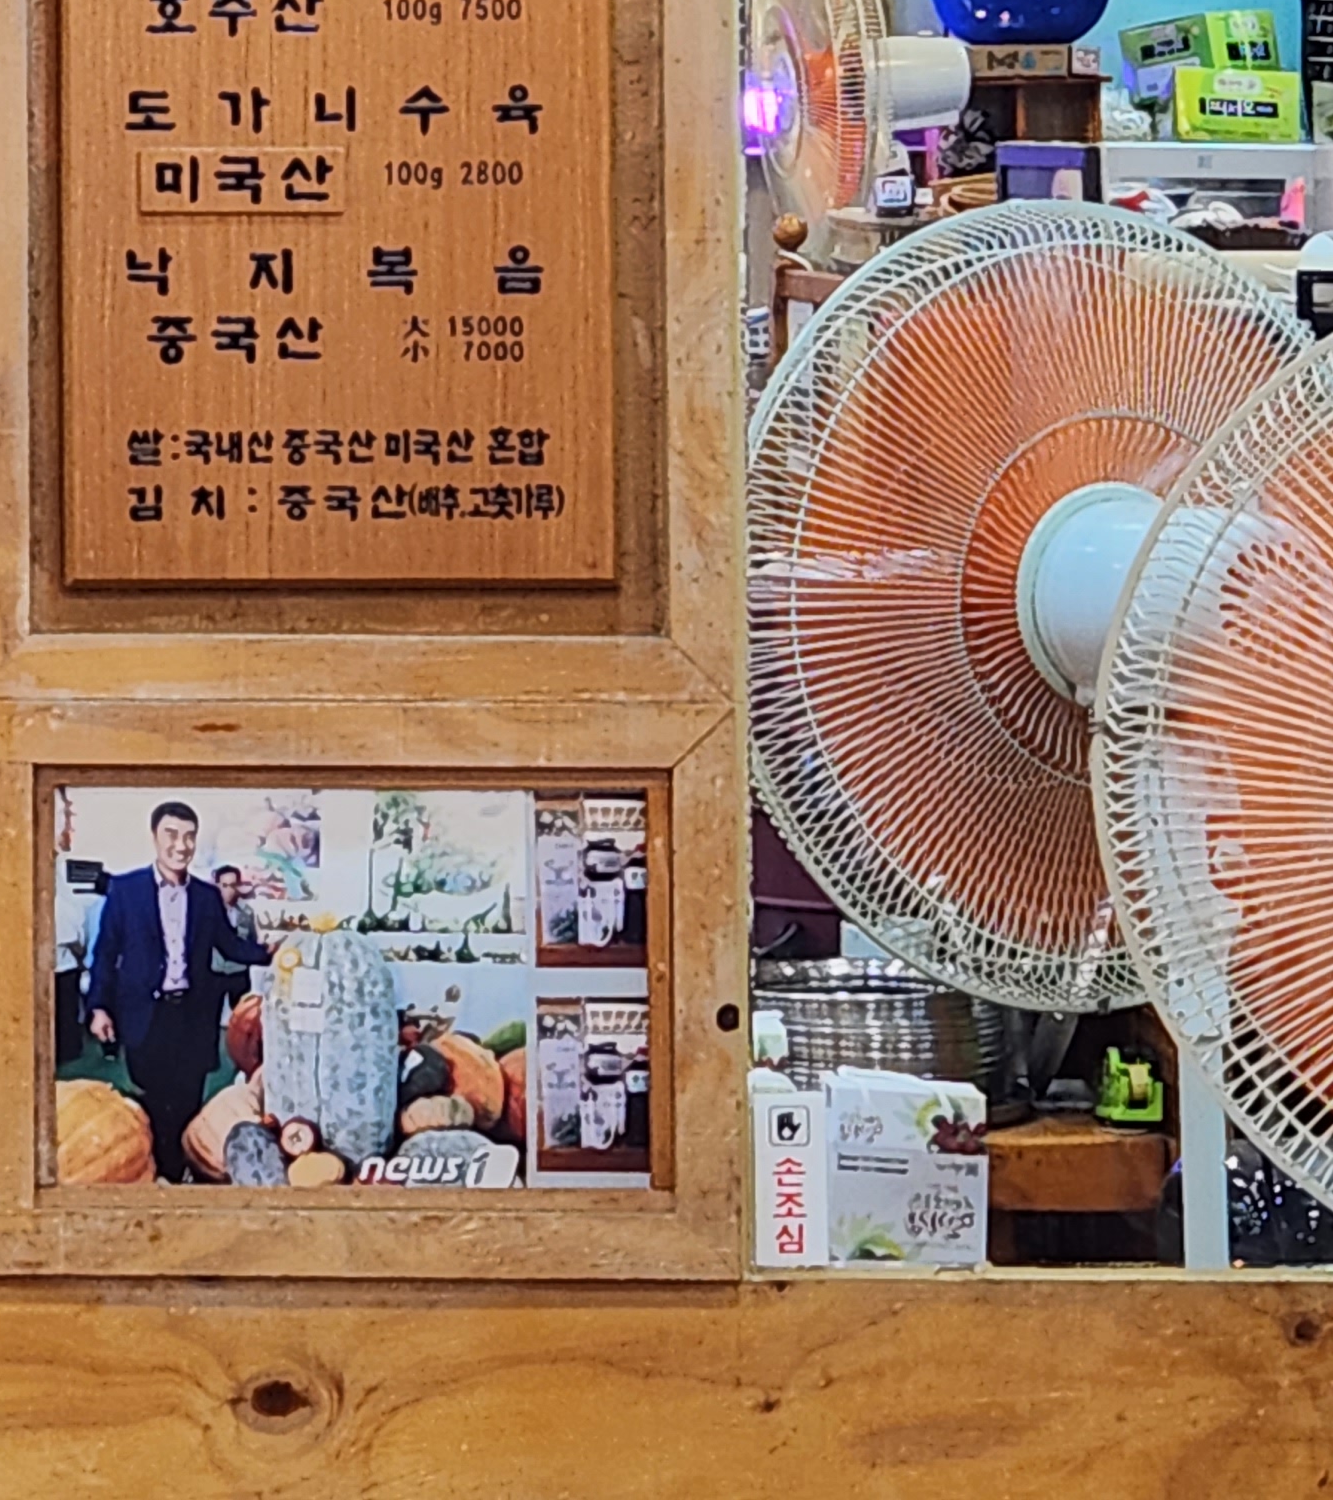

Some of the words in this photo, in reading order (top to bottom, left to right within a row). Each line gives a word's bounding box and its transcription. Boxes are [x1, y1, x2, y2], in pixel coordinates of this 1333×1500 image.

[155, 155, 334, 205] 미국산
[384, 160, 443, 190] 100g
[460, 160, 524, 186] 2800
[146, 315, 323, 365] 중국산
[448, 315, 524, 338] 15000
[463, 340, 524, 363] 7000
[282, 428, 377, 466] 중국산
[384, 428, 475, 467] 미국산
[487, 426, 551, 467] 혼합
[772, 1155, 807, 1256] 손조심
